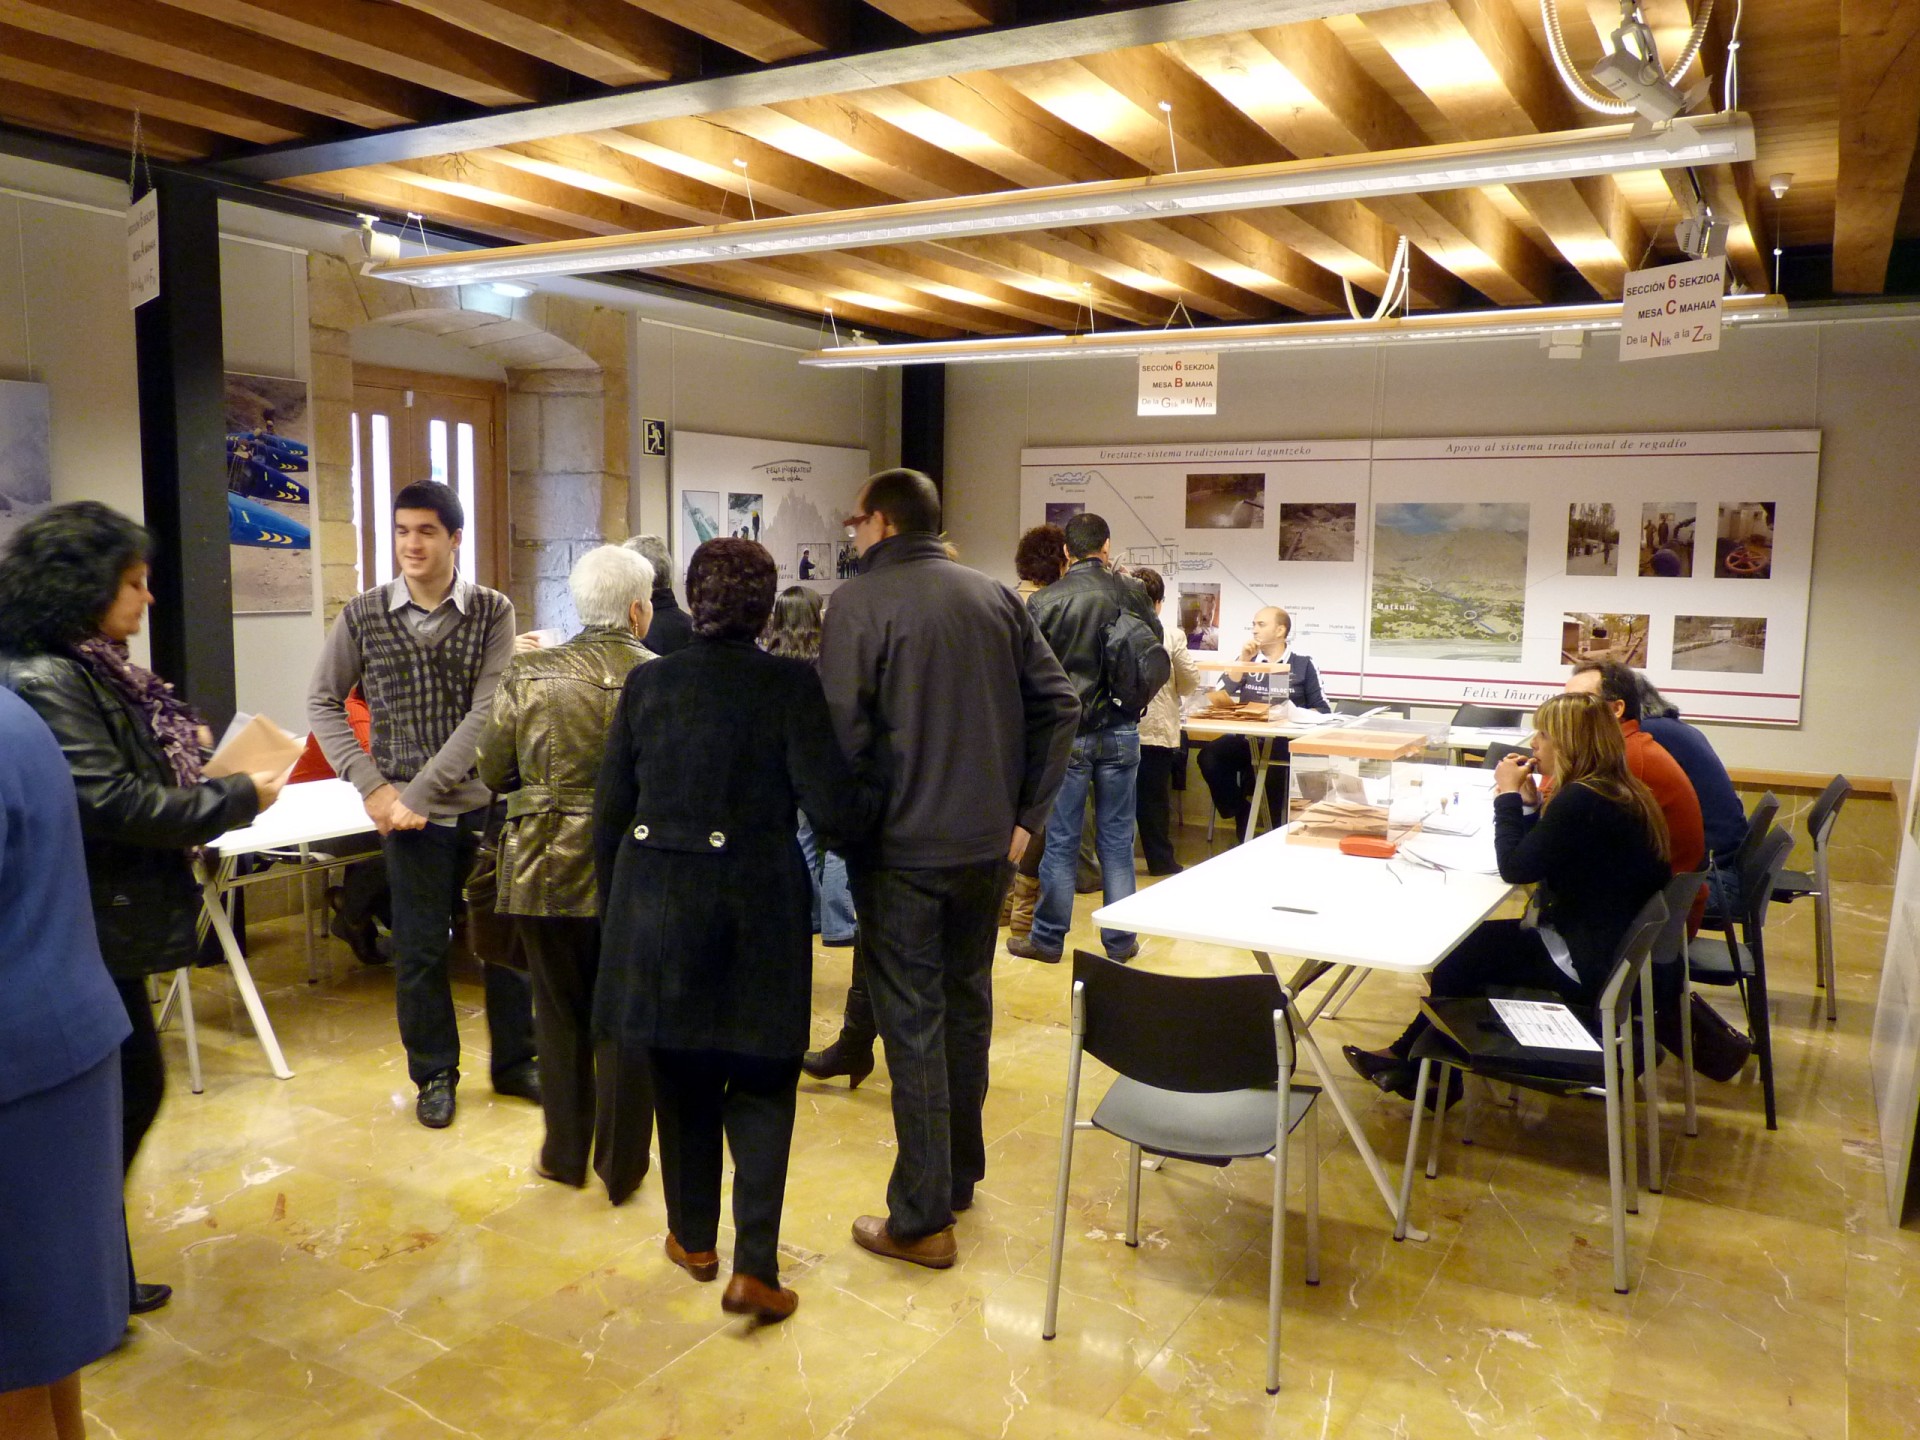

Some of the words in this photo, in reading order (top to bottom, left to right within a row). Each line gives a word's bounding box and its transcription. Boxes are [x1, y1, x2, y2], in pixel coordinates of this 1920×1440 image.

[1626, 281, 1665, 296] SECCIÓN
[1668, 274, 1677, 289] 6
[1679, 273, 1720, 288] SEKZIOA
[1638, 308, 1663, 319] MESA
[1666, 300, 1677, 315] C
[1679, 300, 1716, 313] MAHAIA
[1626, 336, 1638, 345] De
[1640, 334, 1648, 343] la
[1650, 331, 1672, 347] Ntik
[1674, 331, 1680, 339] a
[1682, 329, 1690, 338] la
[1691, 325, 1712, 343] Zra
[1142, 363, 1173, 372] SECCIÓN
[1175, 360, 1182, 371] 6
[1174, 377, 1183, 388] B
[1194, 397, 1213, 408] Mra
[1100, 449, 1182, 459] Ureztatze-sistema
[1185, 447, 1253, 457] tradizionalari
[1257, 446, 1311, 457] laguntzeko
[1446, 443, 1480, 454] Apoyo
[1485, 442, 1496, 452] al
[1500, 442, 1544, 451] sistema
[1548, 440, 1616, 450] tradicional
[1620, 440, 1634, 449] de
[1638, 438, 1687, 451] regadío
[1463, 686, 1498, 698] Felix
